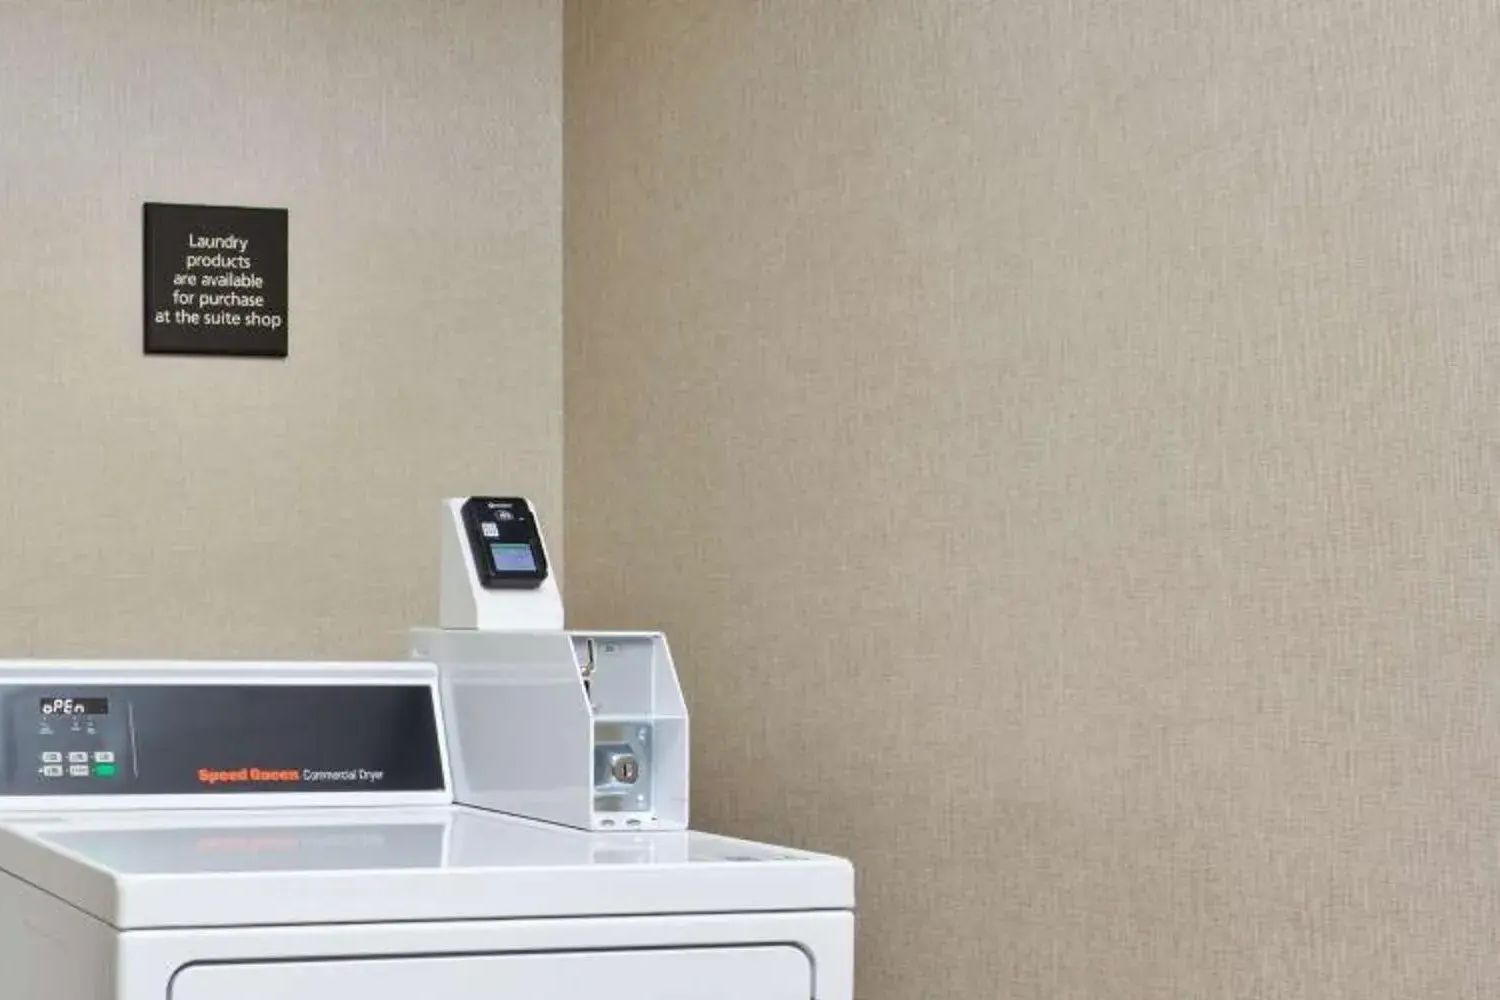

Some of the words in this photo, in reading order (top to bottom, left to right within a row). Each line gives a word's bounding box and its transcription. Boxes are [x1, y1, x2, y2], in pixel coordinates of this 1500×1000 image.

[188, 233, 249, 252] Laundry
[186, 253, 251, 269] products
[173, 273, 197, 286] are
[201, 272, 263, 288] available
[172, 289, 195, 305] for
[199, 291, 264, 308] purchase
[155, 310, 171, 324] at
[175, 309, 200, 325] the
[203, 311, 241, 326] suite
[245, 312, 282, 330] shop
[198, 768, 248, 784] Speed
[250, 768, 300, 781] Queen
[302, 768, 357, 782] Commercial
[359, 768, 385, 782] Dryer
